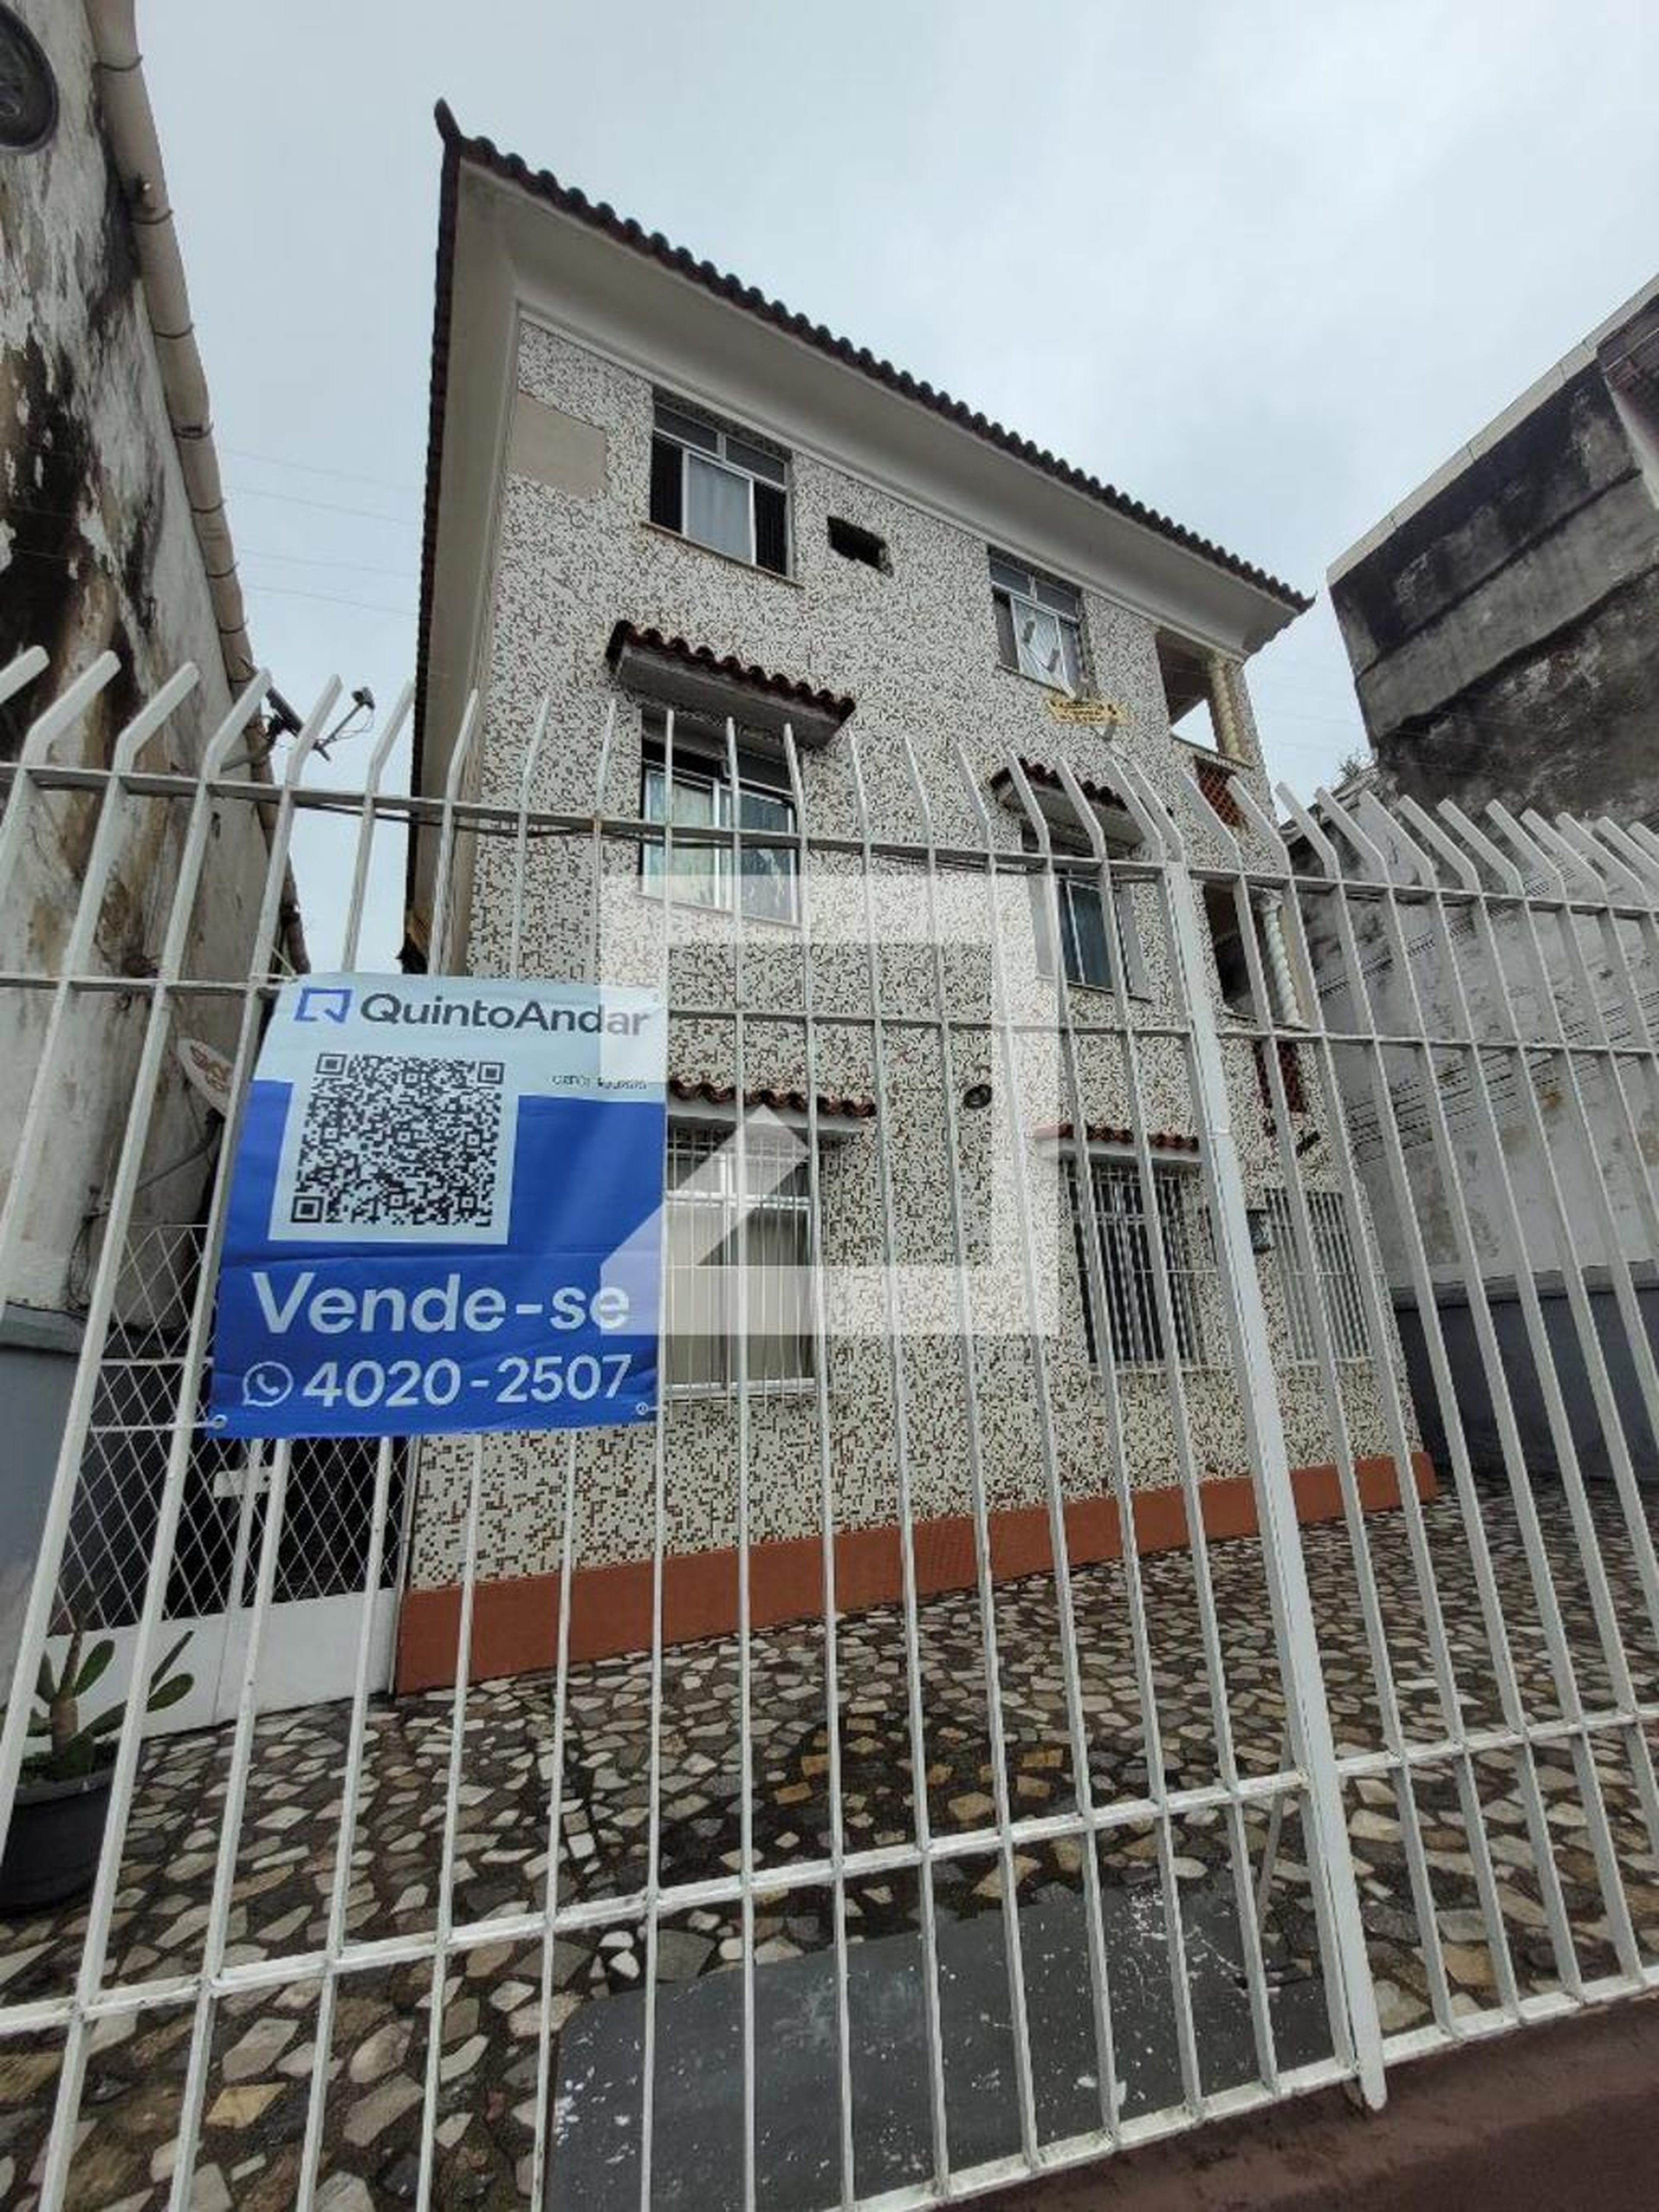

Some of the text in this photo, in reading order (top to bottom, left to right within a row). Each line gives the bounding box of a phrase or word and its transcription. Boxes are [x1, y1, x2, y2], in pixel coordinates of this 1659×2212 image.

[360, 992, 652, 1037] QuintoAndar
[251, 1272, 630, 1334] Vende-se
[303, 1353, 632, 1407] 4020-2507
